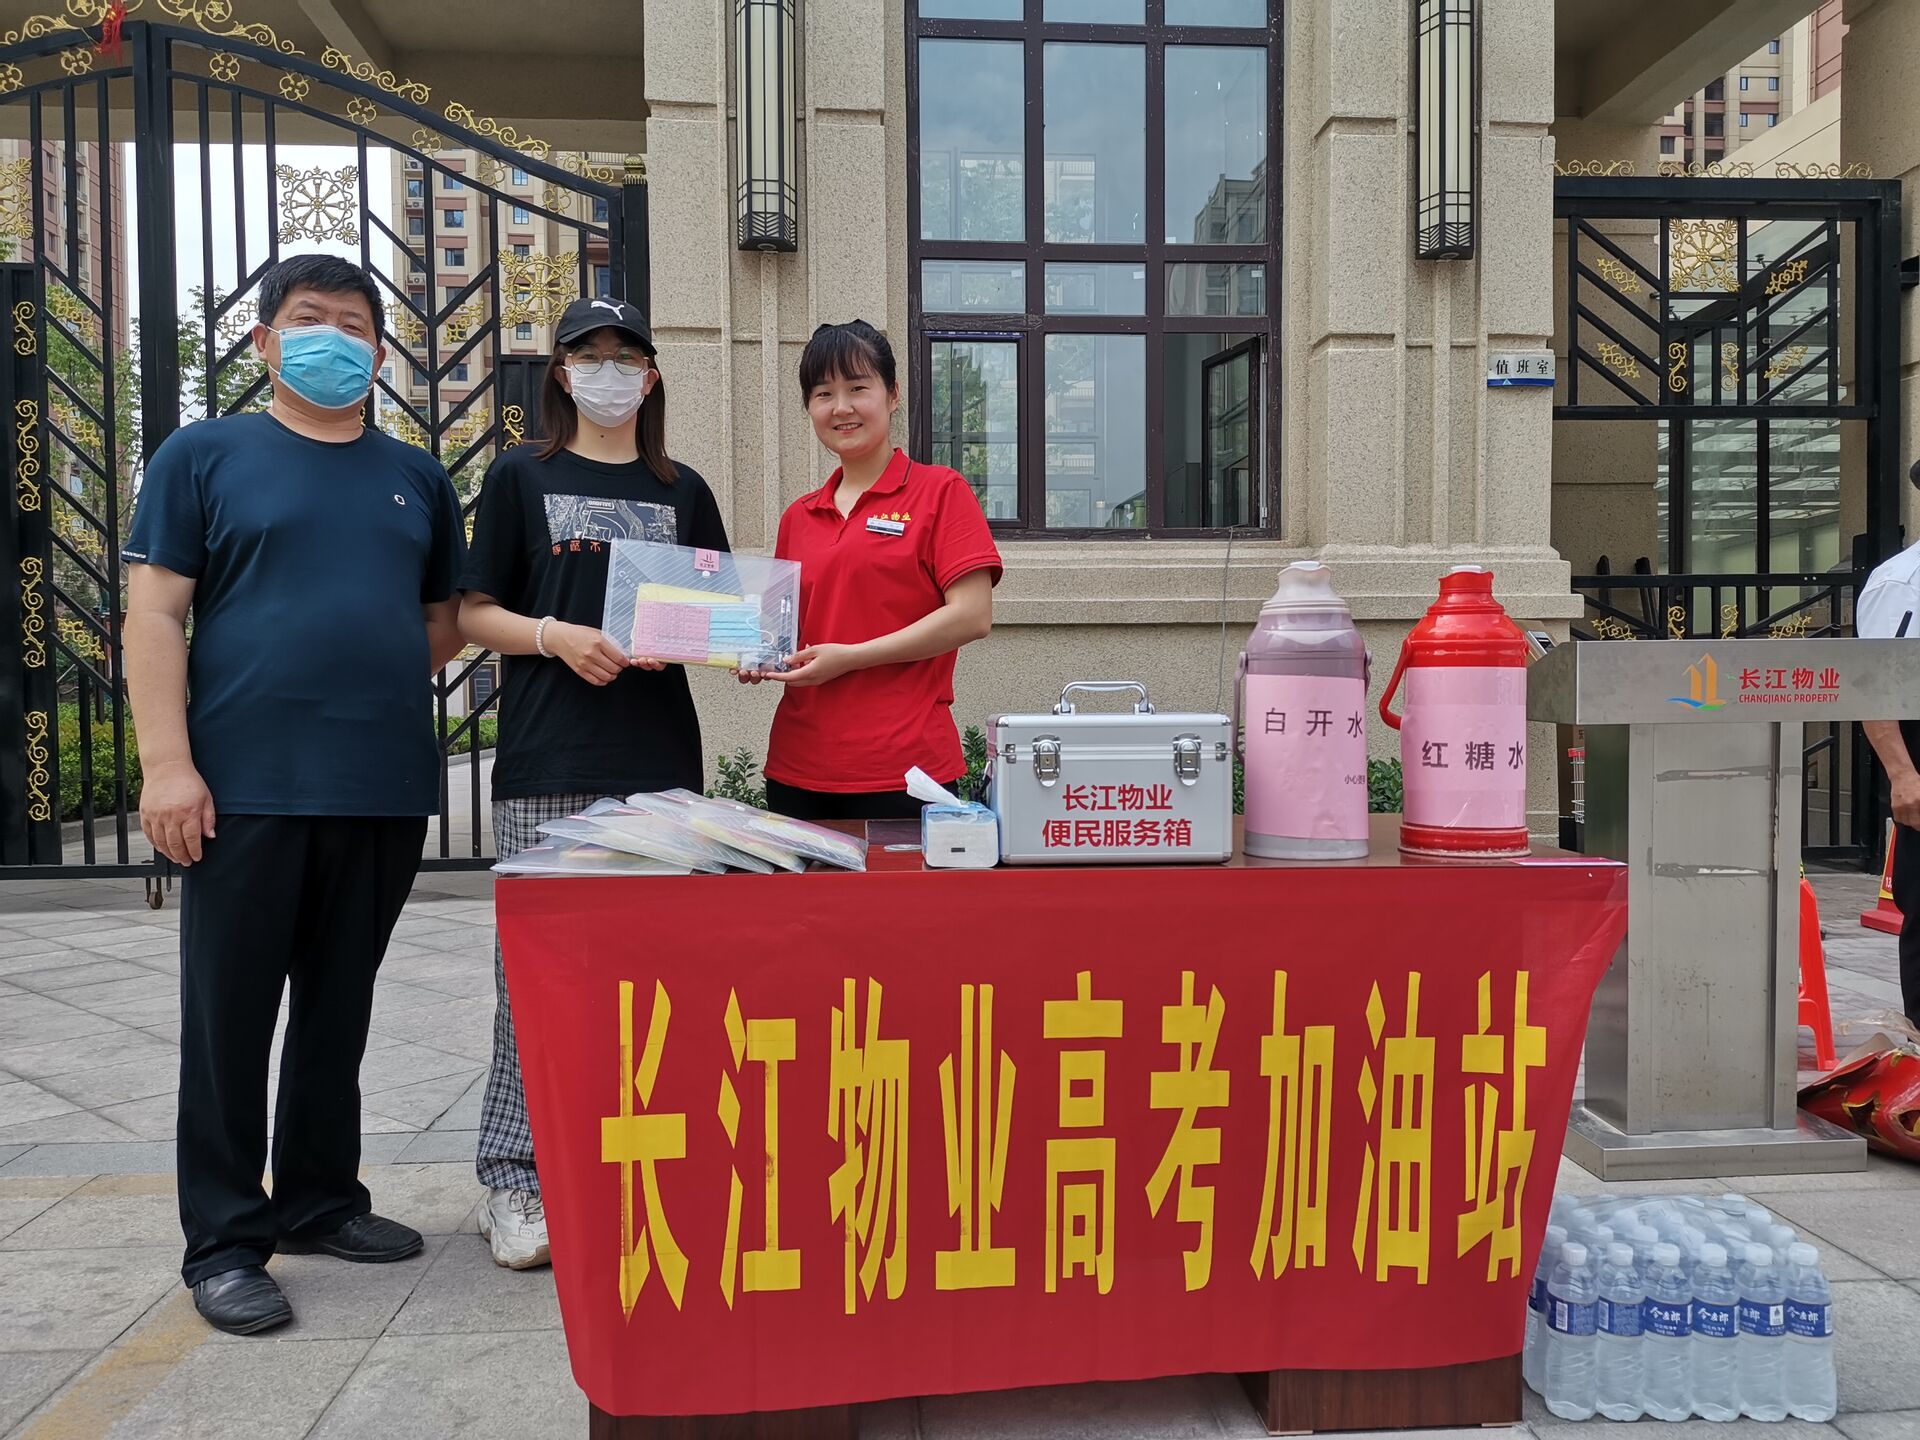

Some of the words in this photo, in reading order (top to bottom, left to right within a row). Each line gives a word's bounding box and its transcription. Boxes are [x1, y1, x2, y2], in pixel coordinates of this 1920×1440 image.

[1496, 359, 1549, 375] 值班室
[1739, 668, 1840, 690] 长江物业
[1739, 693, 1792, 704] CHANGJIANG
[1794, 693, 1840, 703] PROPERTY
[1265, 707, 1363, 738] 白开水
[1422, 740, 1524, 770] 红糖水
[1062, 783, 1173, 811] 长江物业
[1042, 818, 1192, 847] 便民服务箱
[600, 970, 1547, 1328] 长江物业高考加油站
[1740, 1307, 1760, 1323] 麦郎
